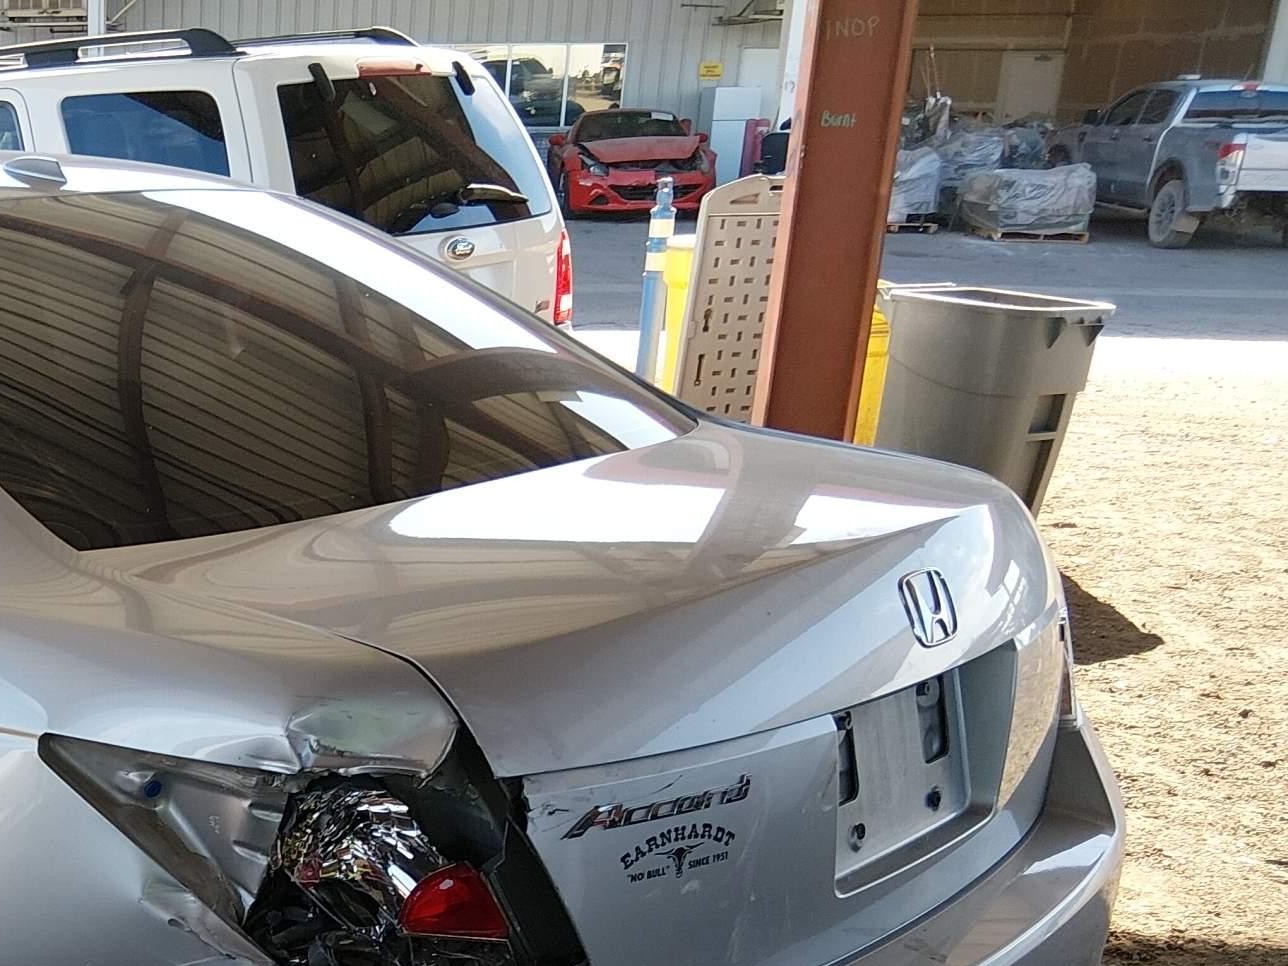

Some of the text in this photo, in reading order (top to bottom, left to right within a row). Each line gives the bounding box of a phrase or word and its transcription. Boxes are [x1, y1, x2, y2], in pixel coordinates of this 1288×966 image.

[560, 772, 753, 840] Accord
[620, 823, 736, 870] EARNHARDT
[687, 855, 710, 870] SINCE
